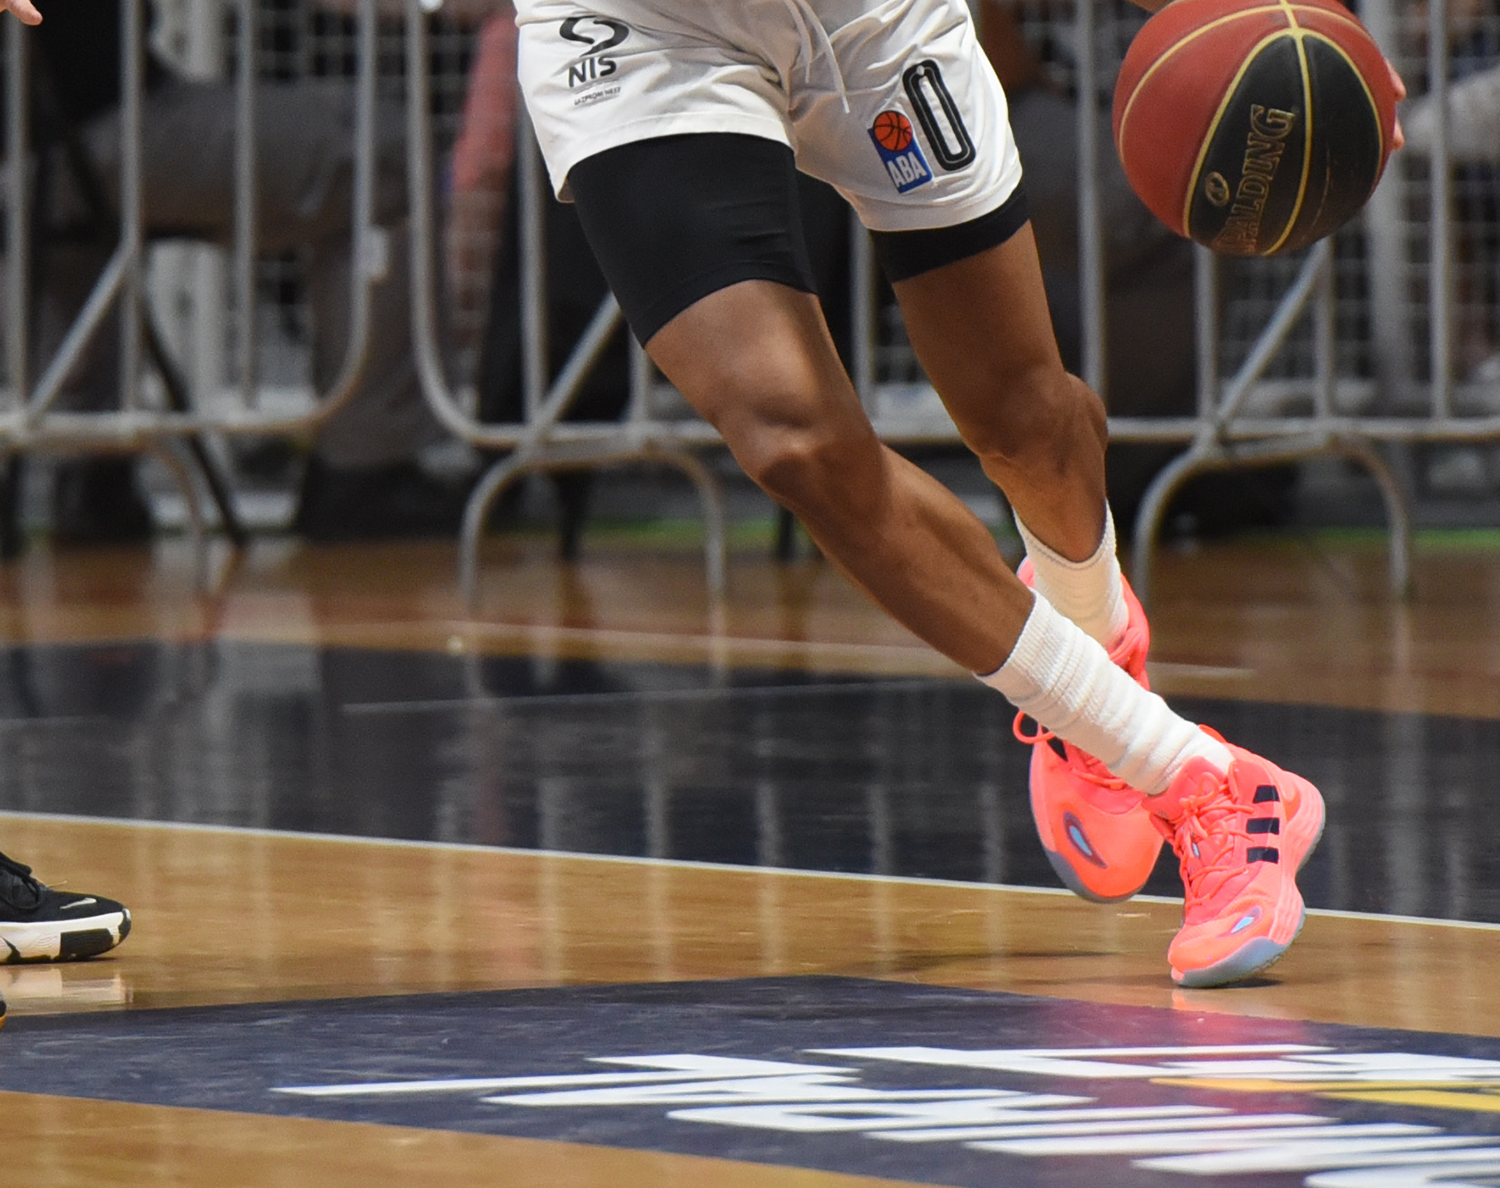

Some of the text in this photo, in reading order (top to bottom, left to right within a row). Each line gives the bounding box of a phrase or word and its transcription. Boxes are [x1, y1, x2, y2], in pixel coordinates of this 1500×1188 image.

[569, 56, 617, 88] NIS
[902, 58, 975, 171] 0
[886, 151, 928, 188] ABA
